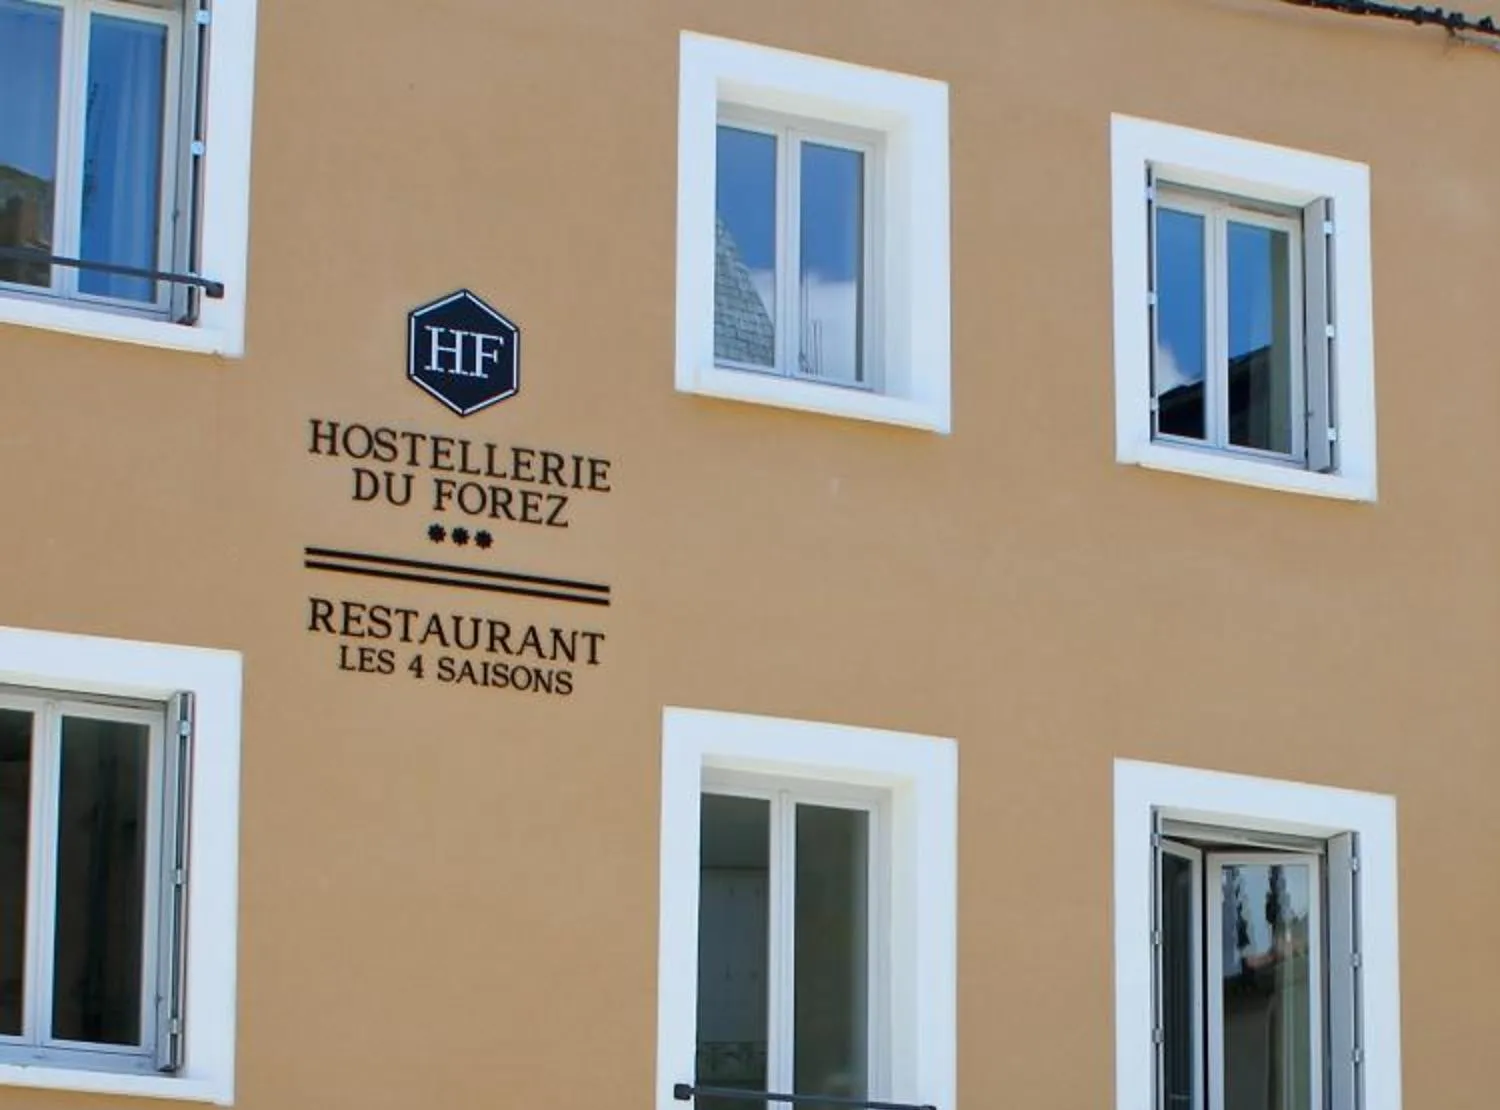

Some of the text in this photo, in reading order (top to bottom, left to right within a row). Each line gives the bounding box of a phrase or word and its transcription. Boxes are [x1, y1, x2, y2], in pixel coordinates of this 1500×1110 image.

[424, 325, 505, 379] HF
[308, 418, 612, 493] HOSTELLERIE
[352, 468, 570, 528] DU FOREZ
[308, 597, 606, 665] RESTAURANT
[338, 644, 574, 696] LES 4 SAISONS
